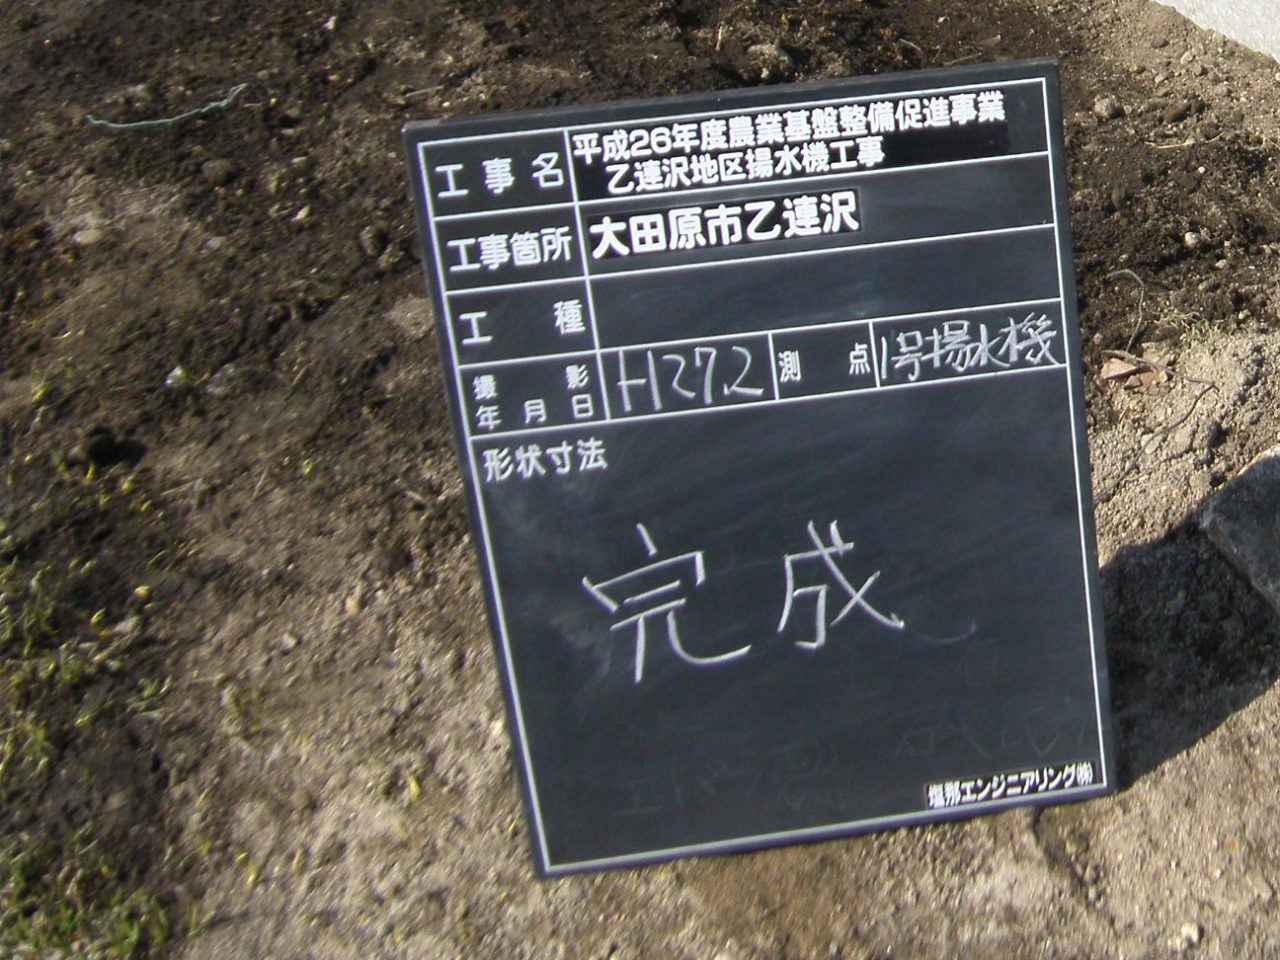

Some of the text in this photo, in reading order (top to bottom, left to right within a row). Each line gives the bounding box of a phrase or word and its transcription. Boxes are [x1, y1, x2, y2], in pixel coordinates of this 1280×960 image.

[573, 91, 1006, 165] 平成26年度農業基盤整備促進事業
[435, 152, 564, 198] 工事名
[605, 136, 885, 195] 乙連沢地区揚水機工事
[447, 226, 572, 272] 工事箇所
[589, 190, 860, 260] 大田原市乙連沢
[459, 299, 586, 345] 工種
[483, 437, 608, 482] 形状寸法
[582, 519, 905, 684] 完成
